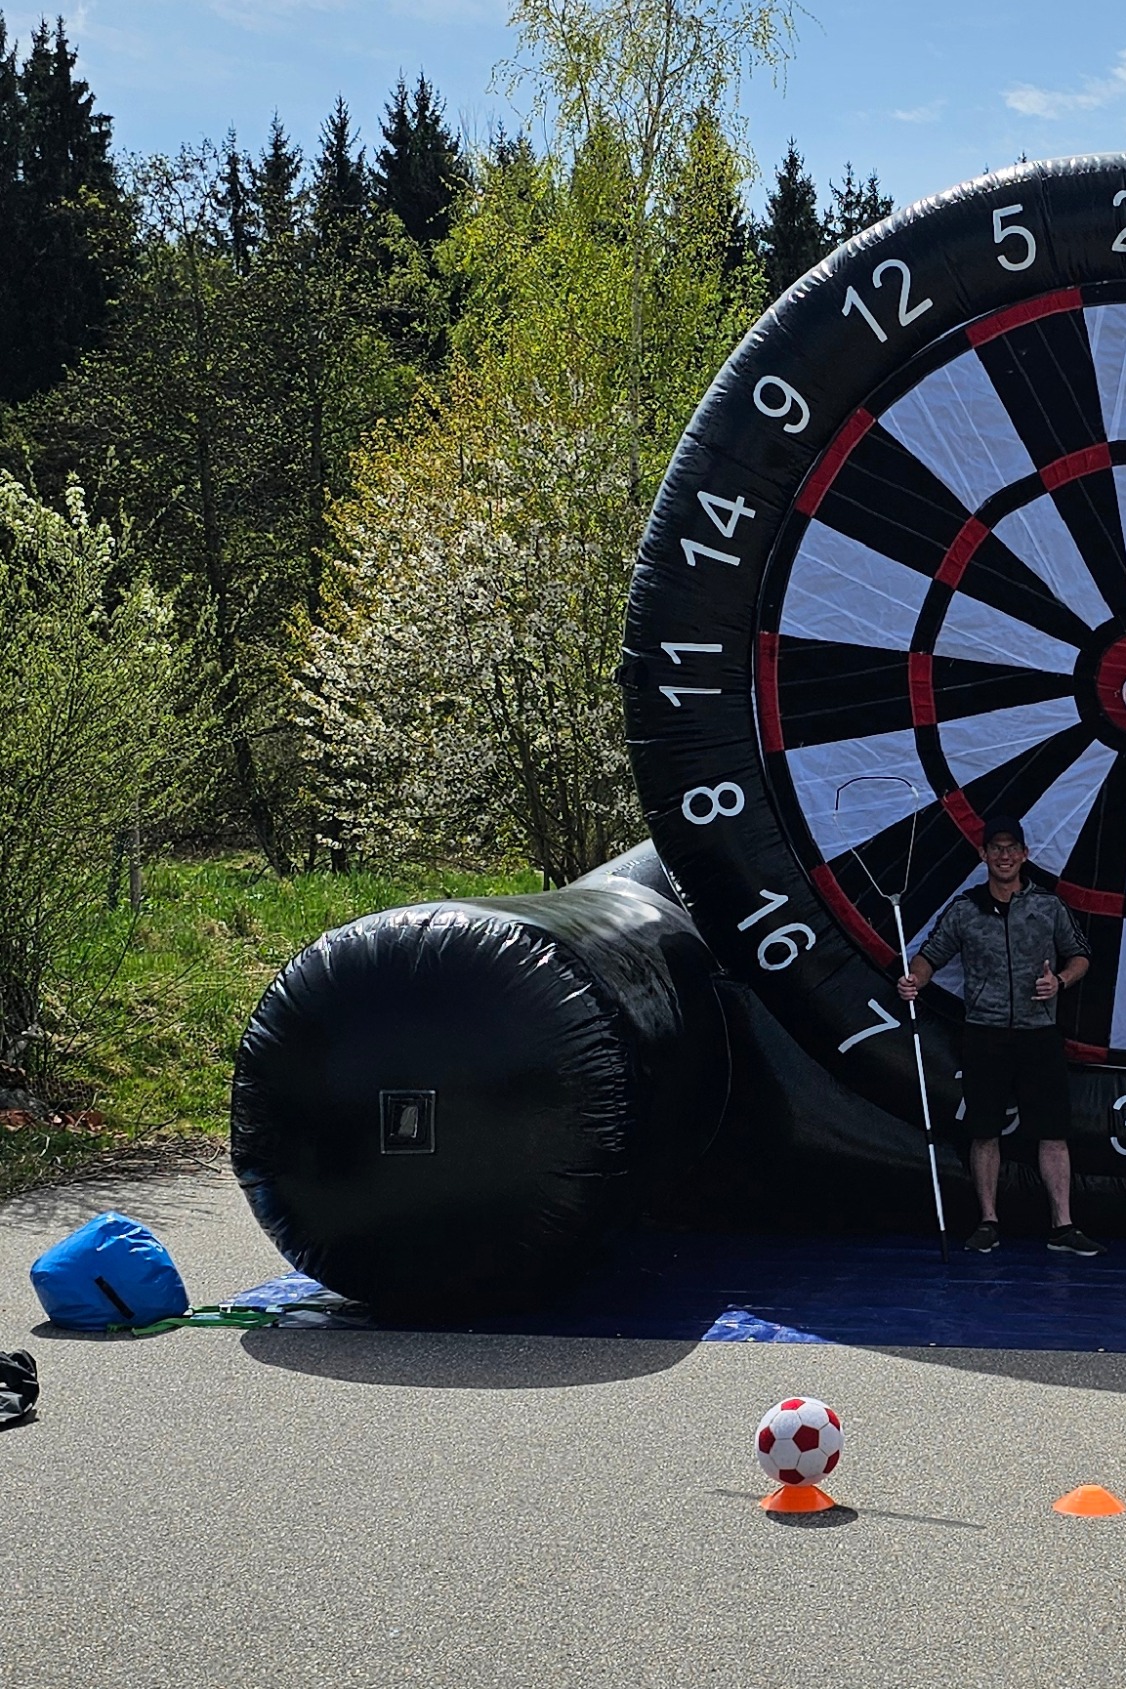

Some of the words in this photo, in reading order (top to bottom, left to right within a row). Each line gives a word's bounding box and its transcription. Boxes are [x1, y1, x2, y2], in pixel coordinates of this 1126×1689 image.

[993, 204, 1037, 272] 5
[842, 259, 934, 343] 12
[753, 376, 811, 434] 9
[681, 491, 756, 567] 14
[659, 642, 723, 707] 11
[682, 782, 745, 825] 8
[738, 889, 816, 971] 16
[838, 998, 900, 1053] 7
